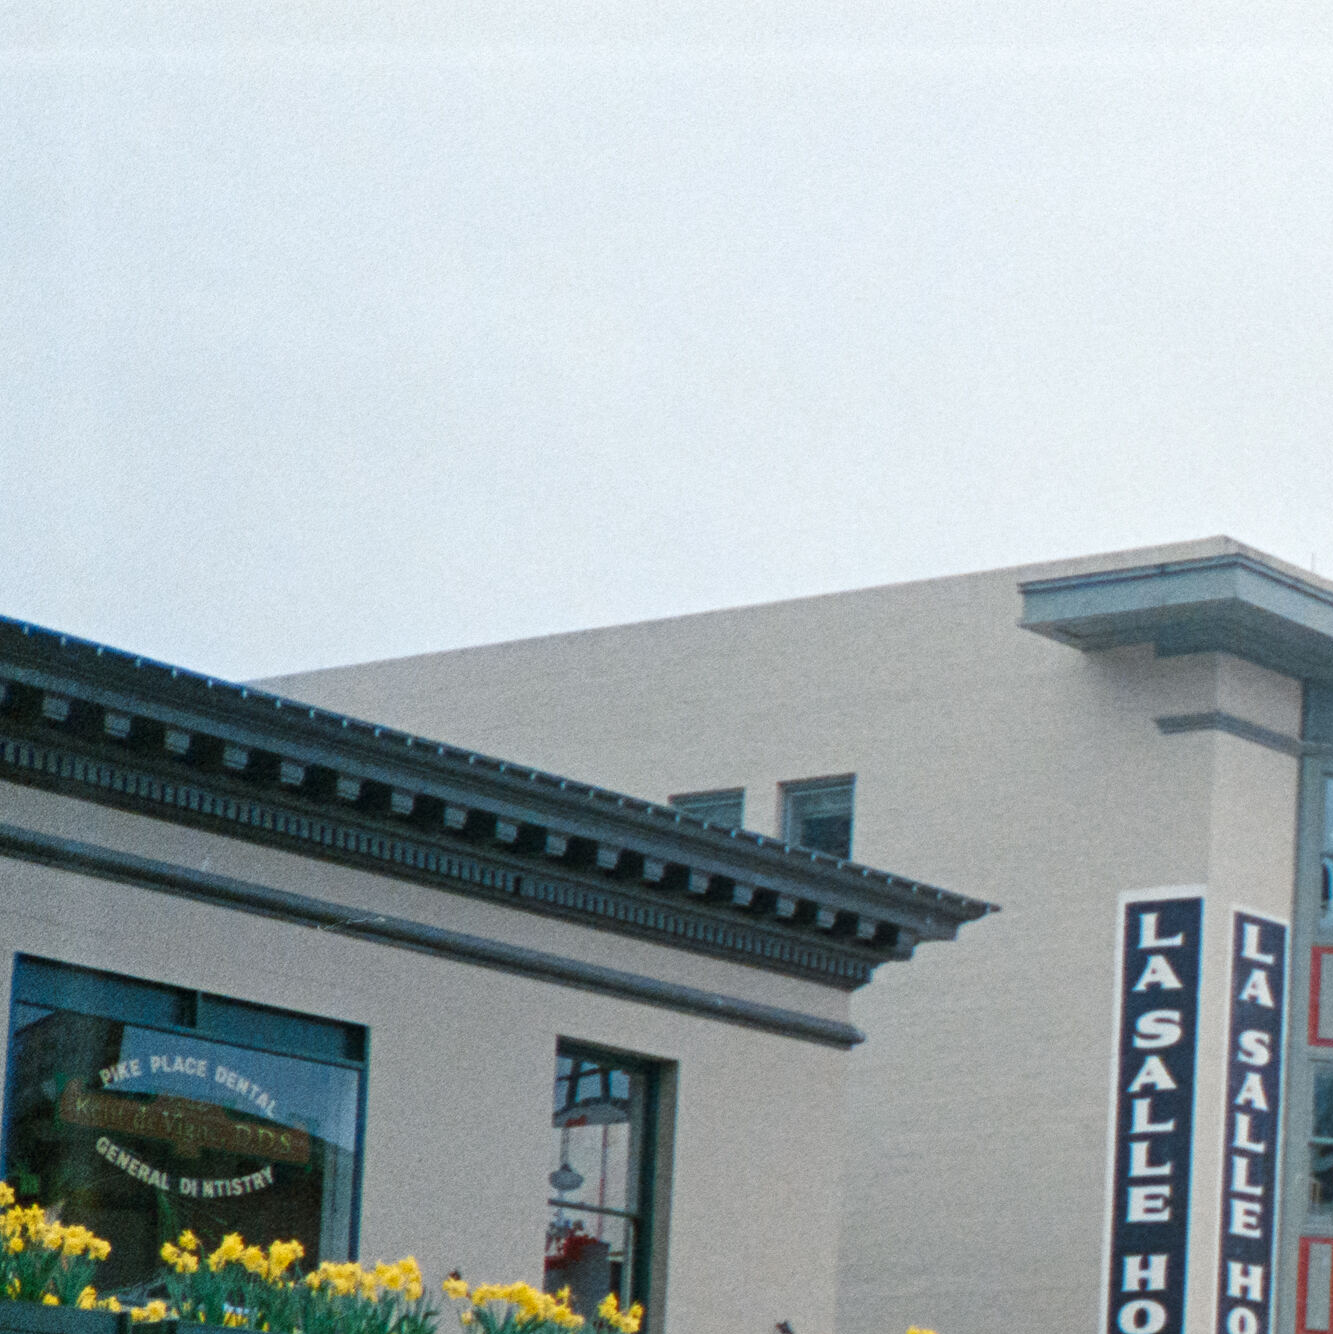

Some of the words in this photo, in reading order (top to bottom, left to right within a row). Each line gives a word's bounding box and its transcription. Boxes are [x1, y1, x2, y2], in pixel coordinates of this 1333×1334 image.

[1131, 912, 1185, 993] LA
[1237, 922, 1275, 1009] LA
[99, 1058, 143, 1088] PIKE
[150, 1054, 209, 1078] PLACE
[213, 1064, 278, 1119] DENTAL
[1125, 1009, 1184, 1224] SALLE
[95, 1136, 170, 1191] GENERAL
[1227, 1029, 1272, 1241] SALLE
